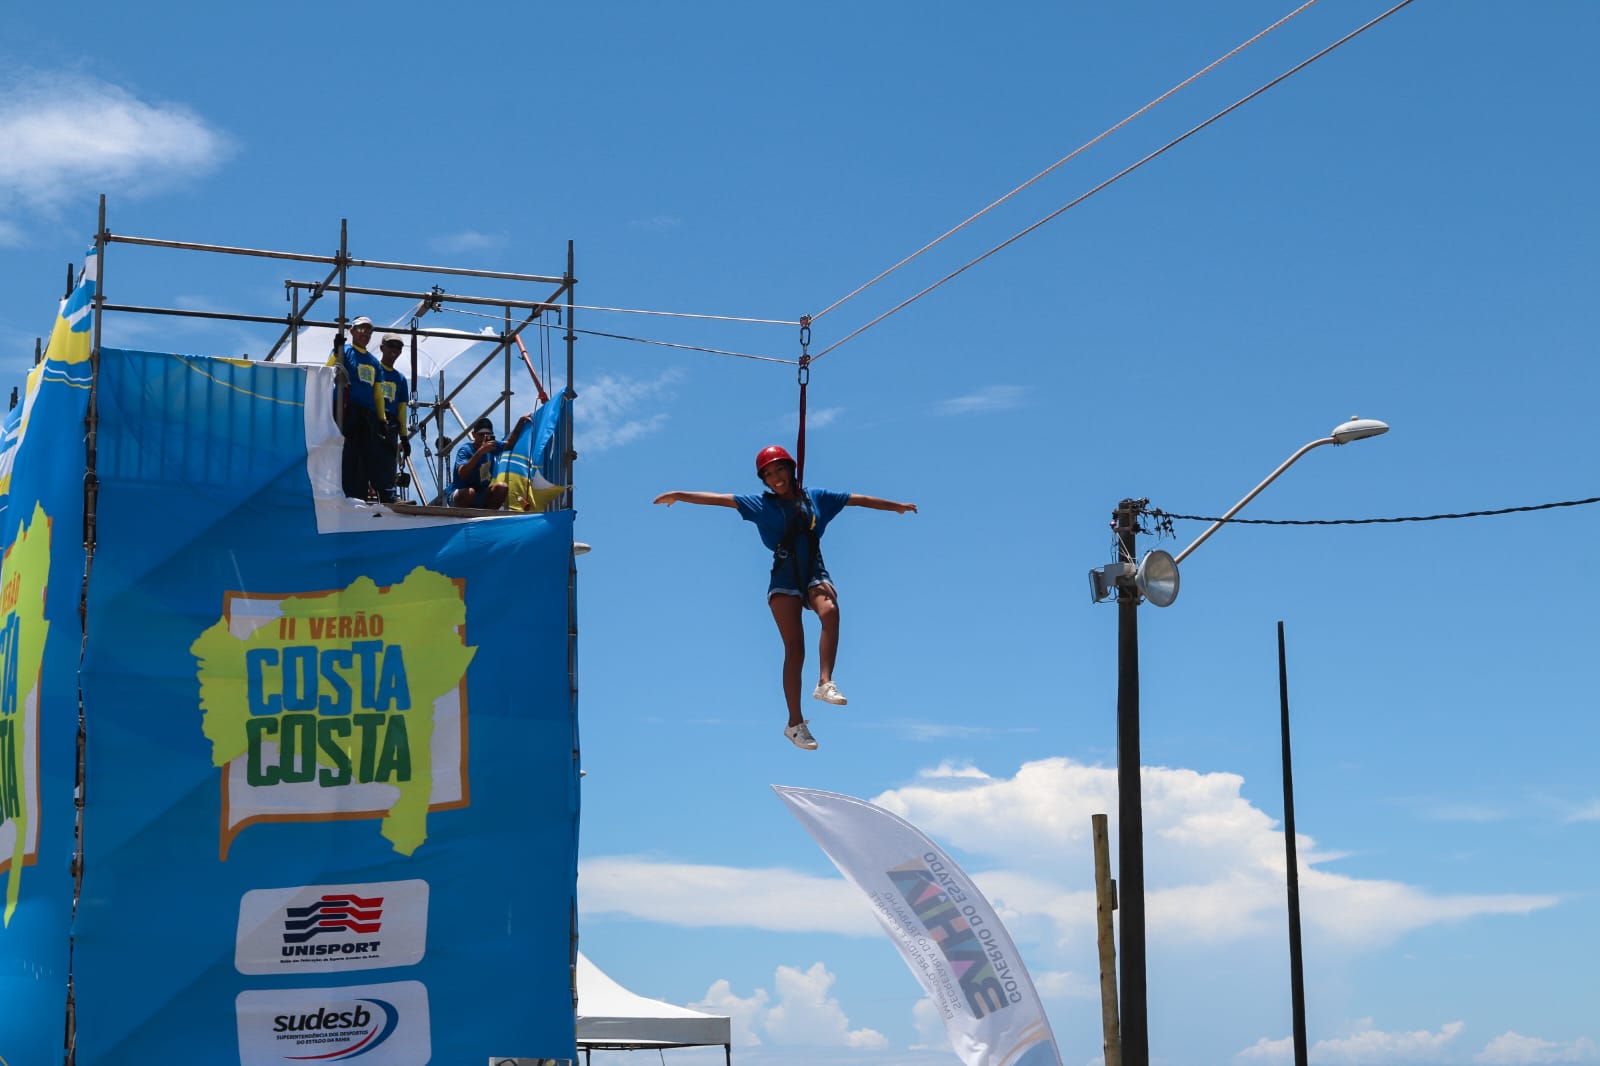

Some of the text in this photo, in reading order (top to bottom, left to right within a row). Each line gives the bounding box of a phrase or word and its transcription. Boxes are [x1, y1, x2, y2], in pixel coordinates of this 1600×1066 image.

[279, 611, 384, 640] II VERÃO
[246, 640, 411, 716] COSTA
[246, 714, 411, 788] COSTA
[282, 941, 380, 956] UNISPORT
[272, 1005, 370, 1032] sudesb
